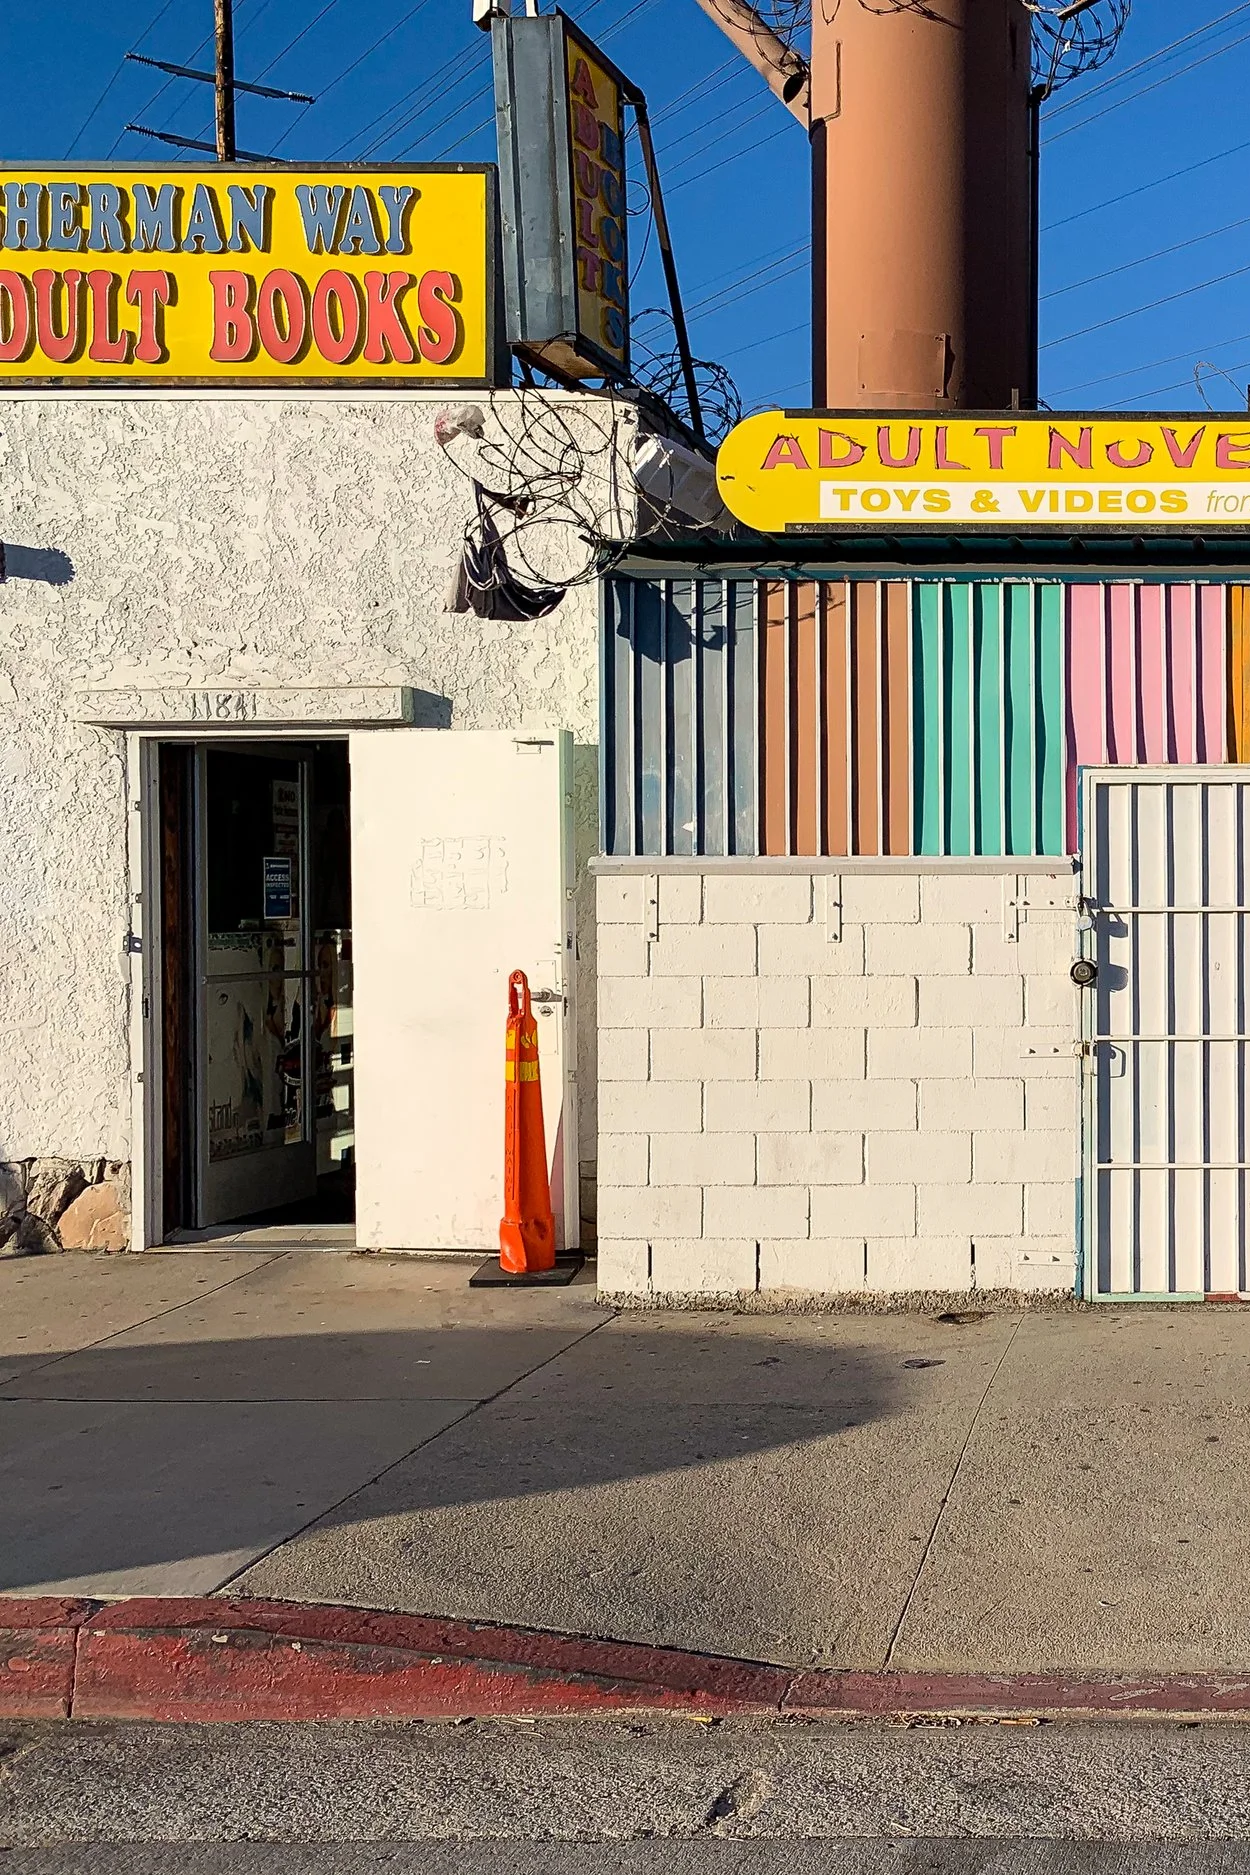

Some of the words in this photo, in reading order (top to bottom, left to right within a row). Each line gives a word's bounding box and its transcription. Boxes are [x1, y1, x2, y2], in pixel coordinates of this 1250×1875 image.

[570, 57, 601, 293] ADULT
[0, 182, 270, 254] HERMAN
[295, 184, 420, 255] WAY
[598, 120, 626, 350] BOOKS
[209, 268, 463, 365] BOOKS
[760, 425, 1018, 470] ADULT
[832, 488, 951, 512] TOYS
[970, 489, 1002, 513] &
[1018, 489, 1189, 513] VIDEOS
